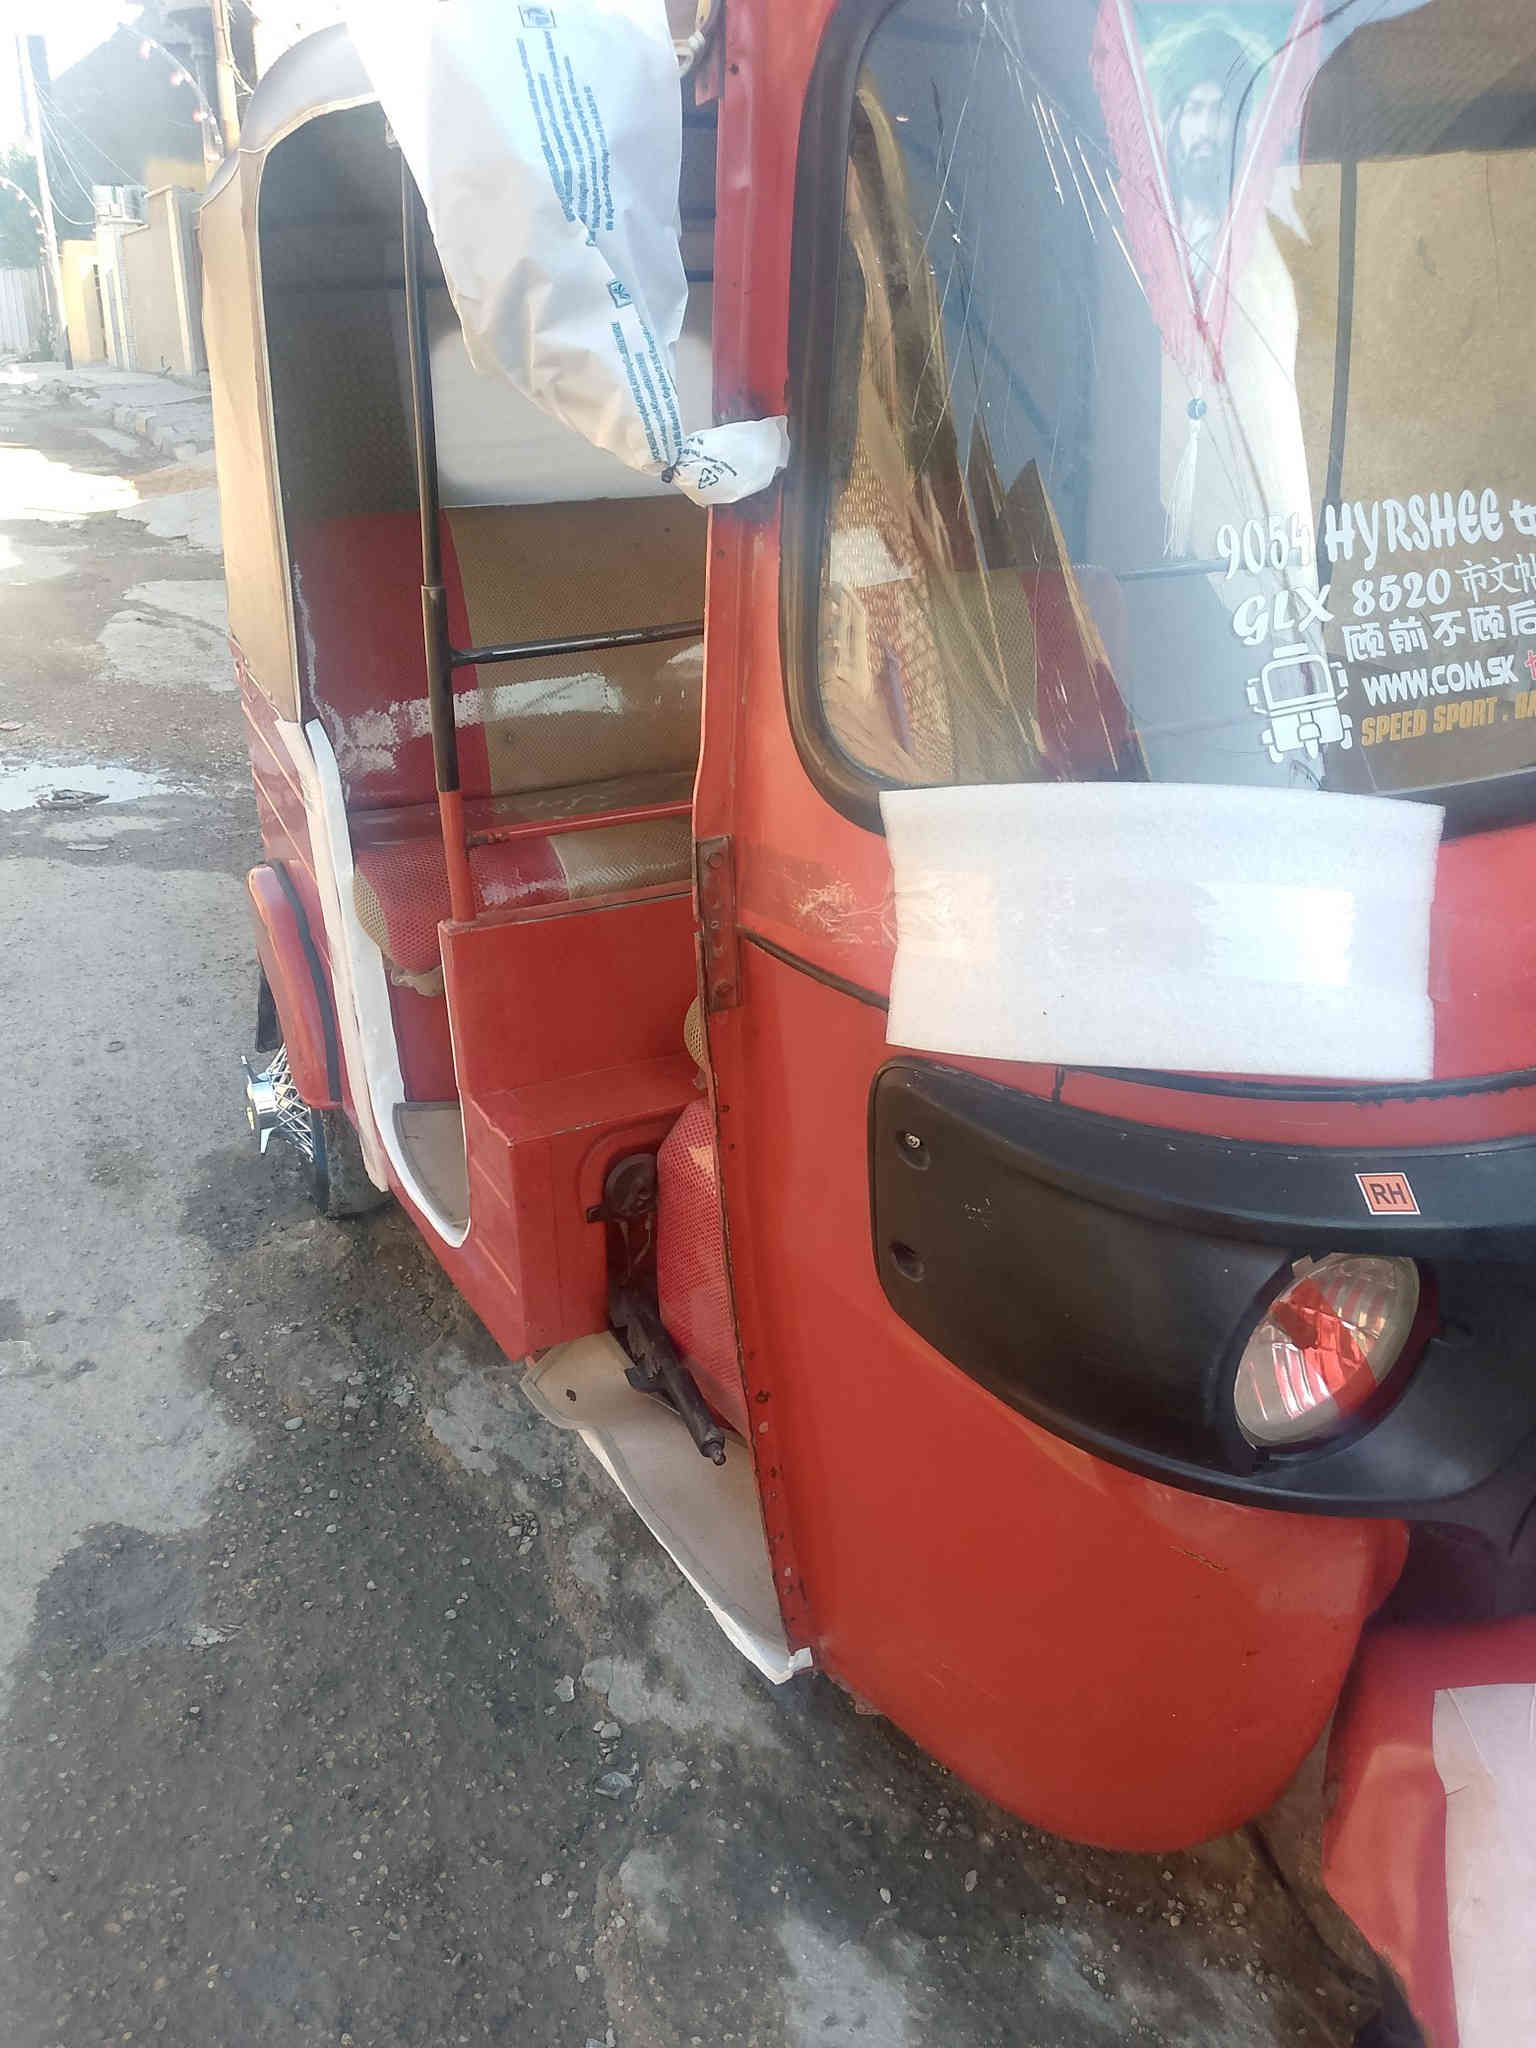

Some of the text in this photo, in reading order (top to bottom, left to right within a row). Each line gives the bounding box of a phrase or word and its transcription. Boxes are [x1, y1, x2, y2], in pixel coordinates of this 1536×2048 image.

[1352, 569, 1451, 617] 8520
[1361, 709, 1427, 747] SPEED
[1433, 696, 1498, 733] SPORT
[1369, 1182, 1407, 1205] RH
